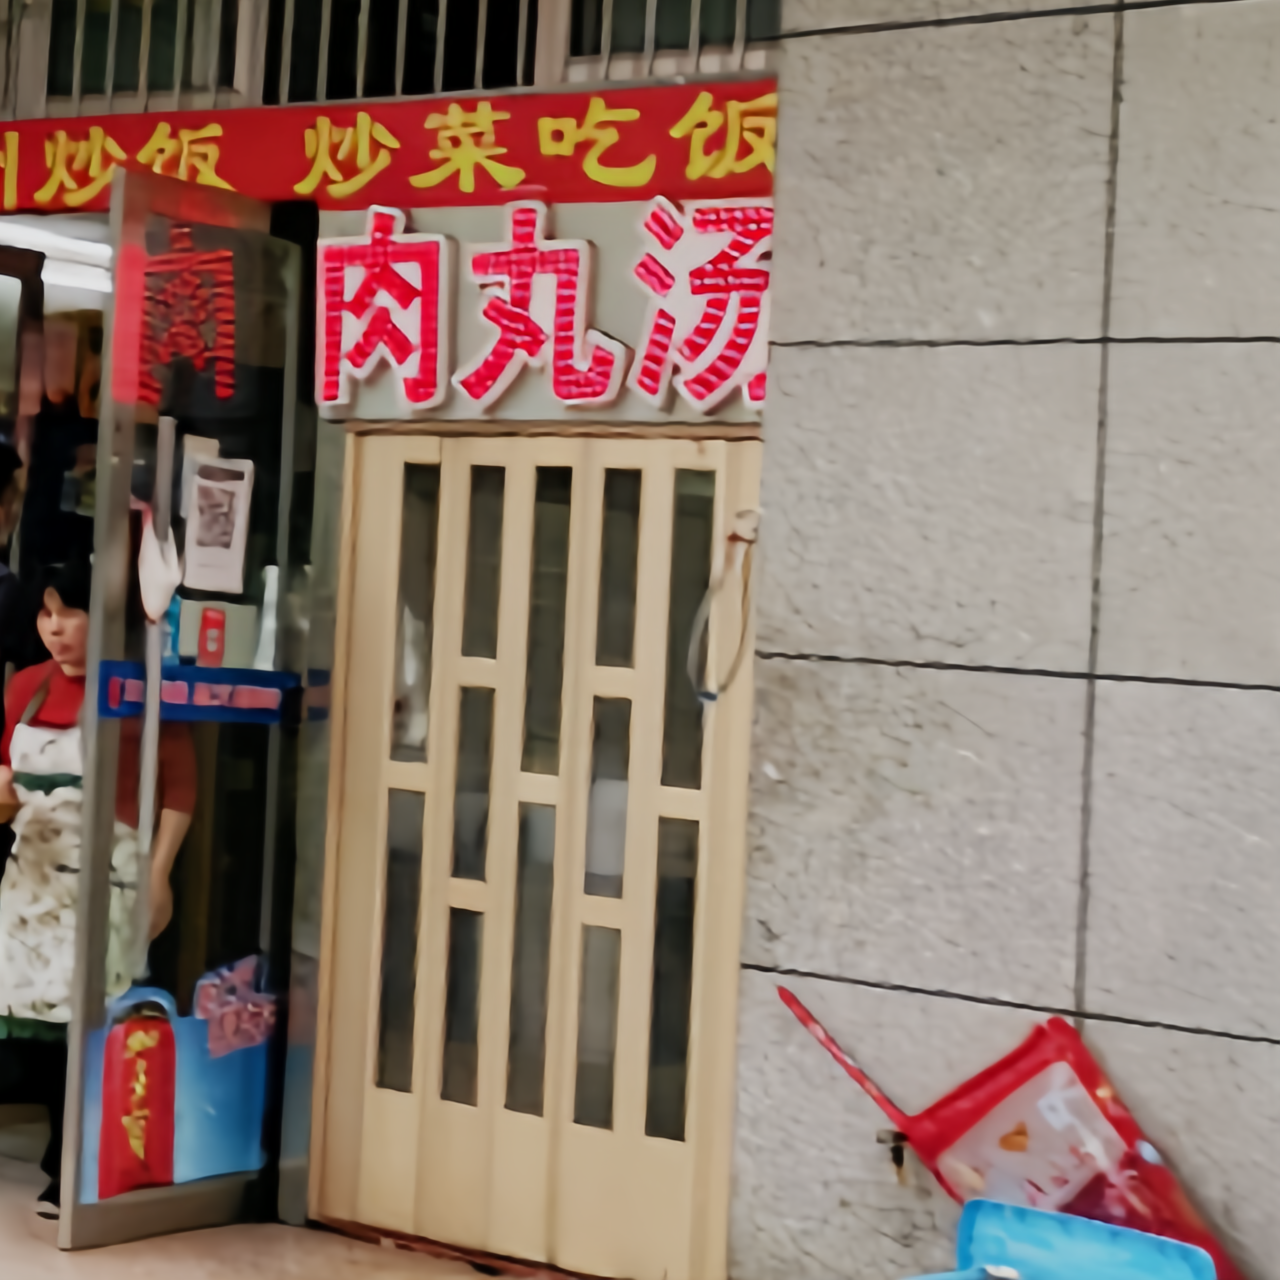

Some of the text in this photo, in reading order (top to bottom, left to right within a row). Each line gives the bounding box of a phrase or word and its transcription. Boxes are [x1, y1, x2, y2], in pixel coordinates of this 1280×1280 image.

[293, 90, 778, 197] 炒菜吃饭
[316, 186, 776, 414] 肉丸汤
